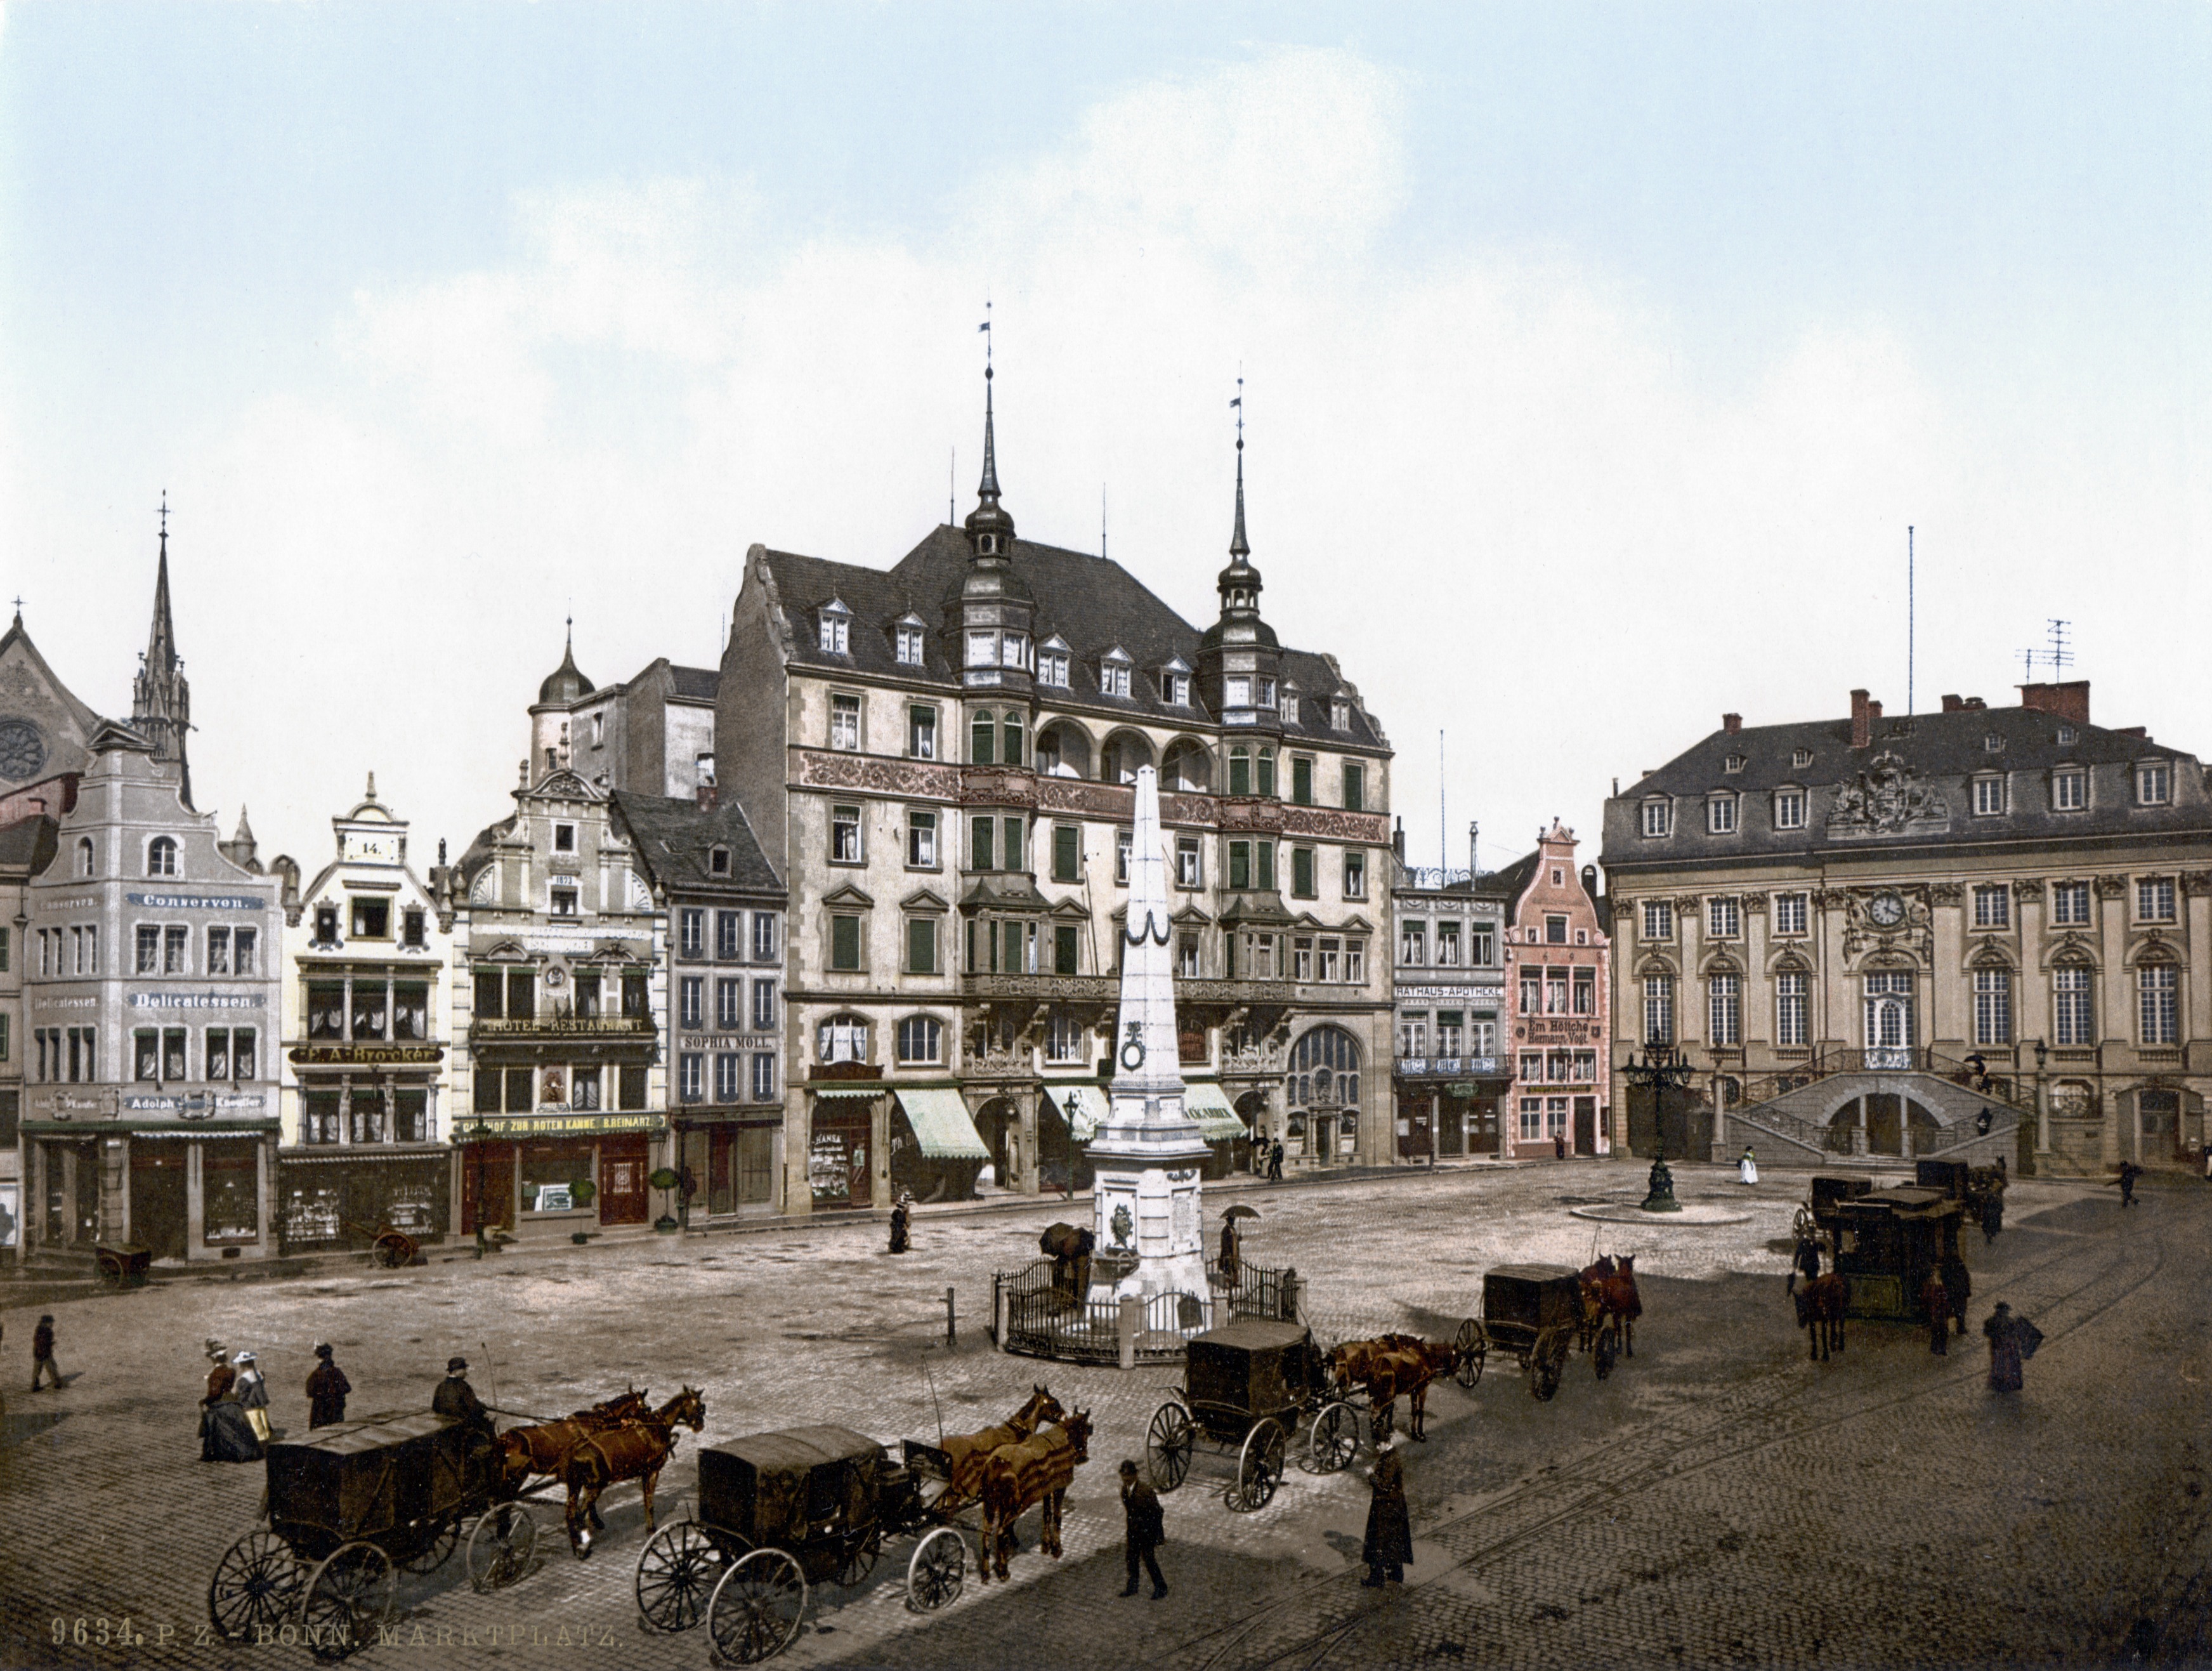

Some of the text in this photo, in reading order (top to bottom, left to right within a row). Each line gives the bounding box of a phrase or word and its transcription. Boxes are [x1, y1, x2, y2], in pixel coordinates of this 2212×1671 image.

[143, 894, 249, 908] Conserven.
[136, 993, 255, 1007] Delicatessen.
[551, 1019, 642, 1032] RESTAURANT
[1529, 1019, 1545, 1032] Em
[685, 1037, 771, 1047] SOPHIA MOLL.
[132, 1099, 174, 1110] Adolph
[511, 1121, 528, 1132] ZUR
[533, 1119, 563, 1130] ROTEN
